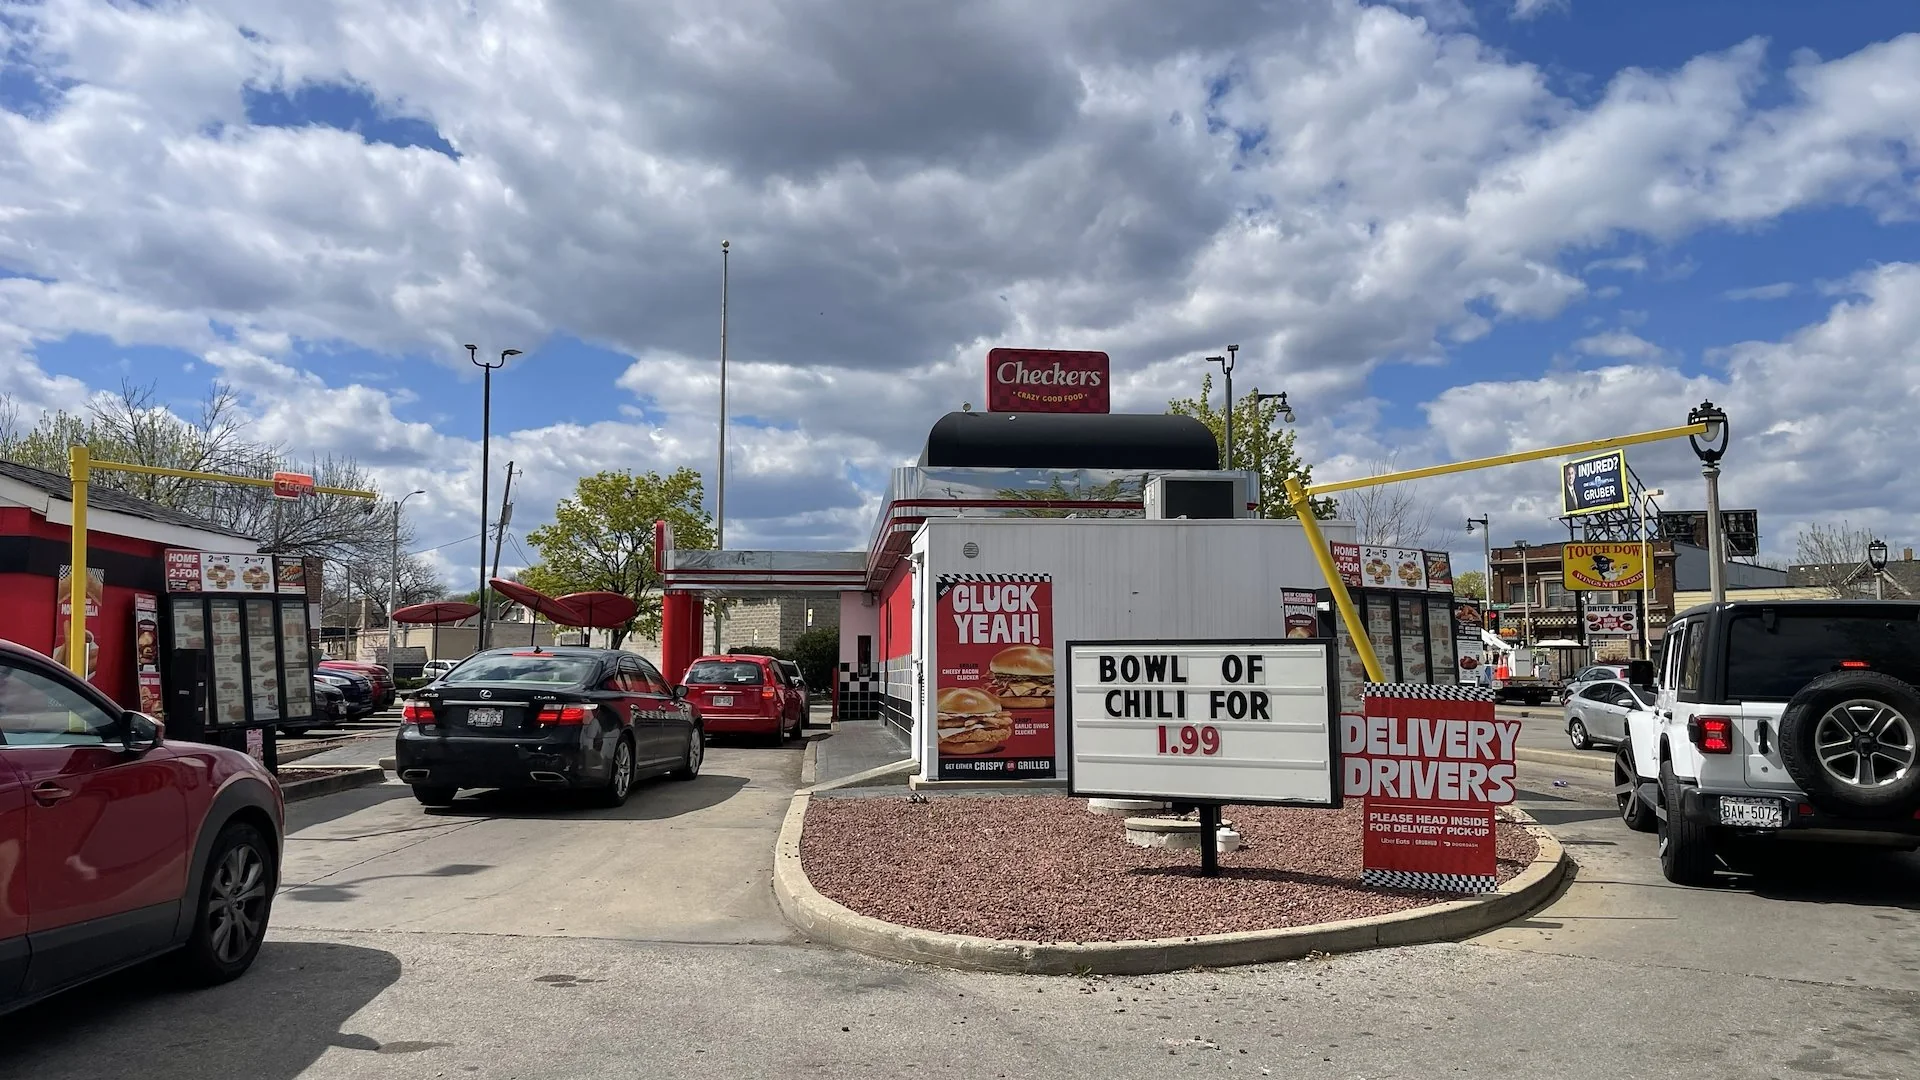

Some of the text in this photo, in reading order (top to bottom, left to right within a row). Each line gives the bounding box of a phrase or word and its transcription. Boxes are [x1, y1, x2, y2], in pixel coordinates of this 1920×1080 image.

[996, 361, 1101, 387] Checkers
[1017, 391, 1040, 401] CRAZY
[1064, 392, 1083, 402] FOOD
[1578, 456, 1619, 477] INJURED?
[1584, 485, 1616, 501] GRUBER
[169, 553, 198, 563] HOME
[1334, 546, 1358, 557] HOME
[1365, 549, 1371, 557] 2
[1398, 551, 1404, 560] 2
[1567, 545, 1610, 560] TOUCH
[169, 568, 199, 578] 2-FOR
[1335, 562, 1359, 572] 2-FOR
[1576, 572, 1601, 587] WINGS
[1609, 573, 1644, 588] SEAFOOD
[940, 585, 951, 597] NEW
[952, 584, 1038, 613] CLUCK
[953, 613, 1040, 645] YEAH!
[1100, 654, 1263, 683] BOWL OF
[1105, 690, 1270, 720] CHILI FOR
[1158, 726, 1220, 755] 1.99
[1340, 715, 1520, 762] DELIVERY
[974, 762, 1004, 770] CRISPY
[1017, 761, 1049, 770] GRILLED
[1344, 757, 1515, 803] DRIVERS
[1370, 813, 1489, 827] PLEASE HEAD INSIDE
[1370, 823, 1489, 836] FOR DELIVERY PICK-UP
